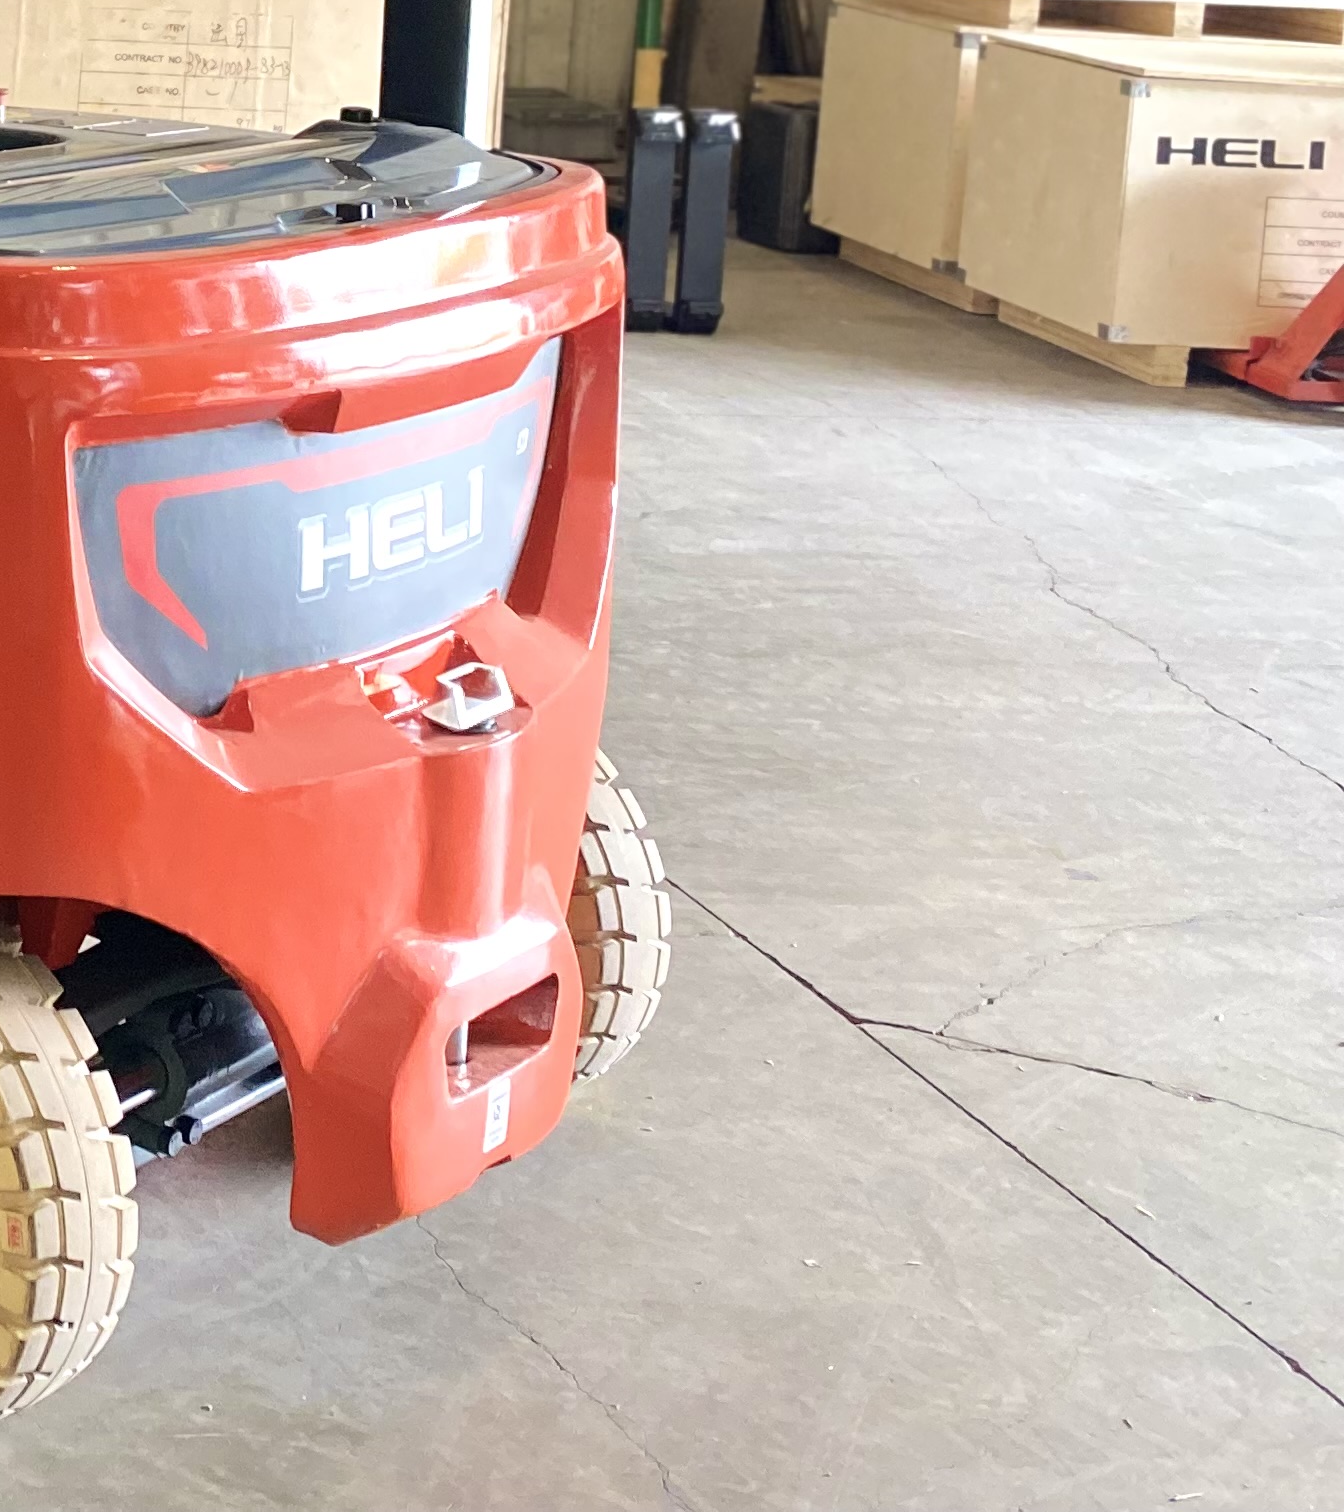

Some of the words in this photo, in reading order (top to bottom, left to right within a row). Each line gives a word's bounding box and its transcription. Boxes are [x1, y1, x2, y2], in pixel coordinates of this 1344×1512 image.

[114, 52, 164, 64] CONTRACT
[1156, 136, 1326, 170] HELI
[296, 464, 486, 603] HELI
